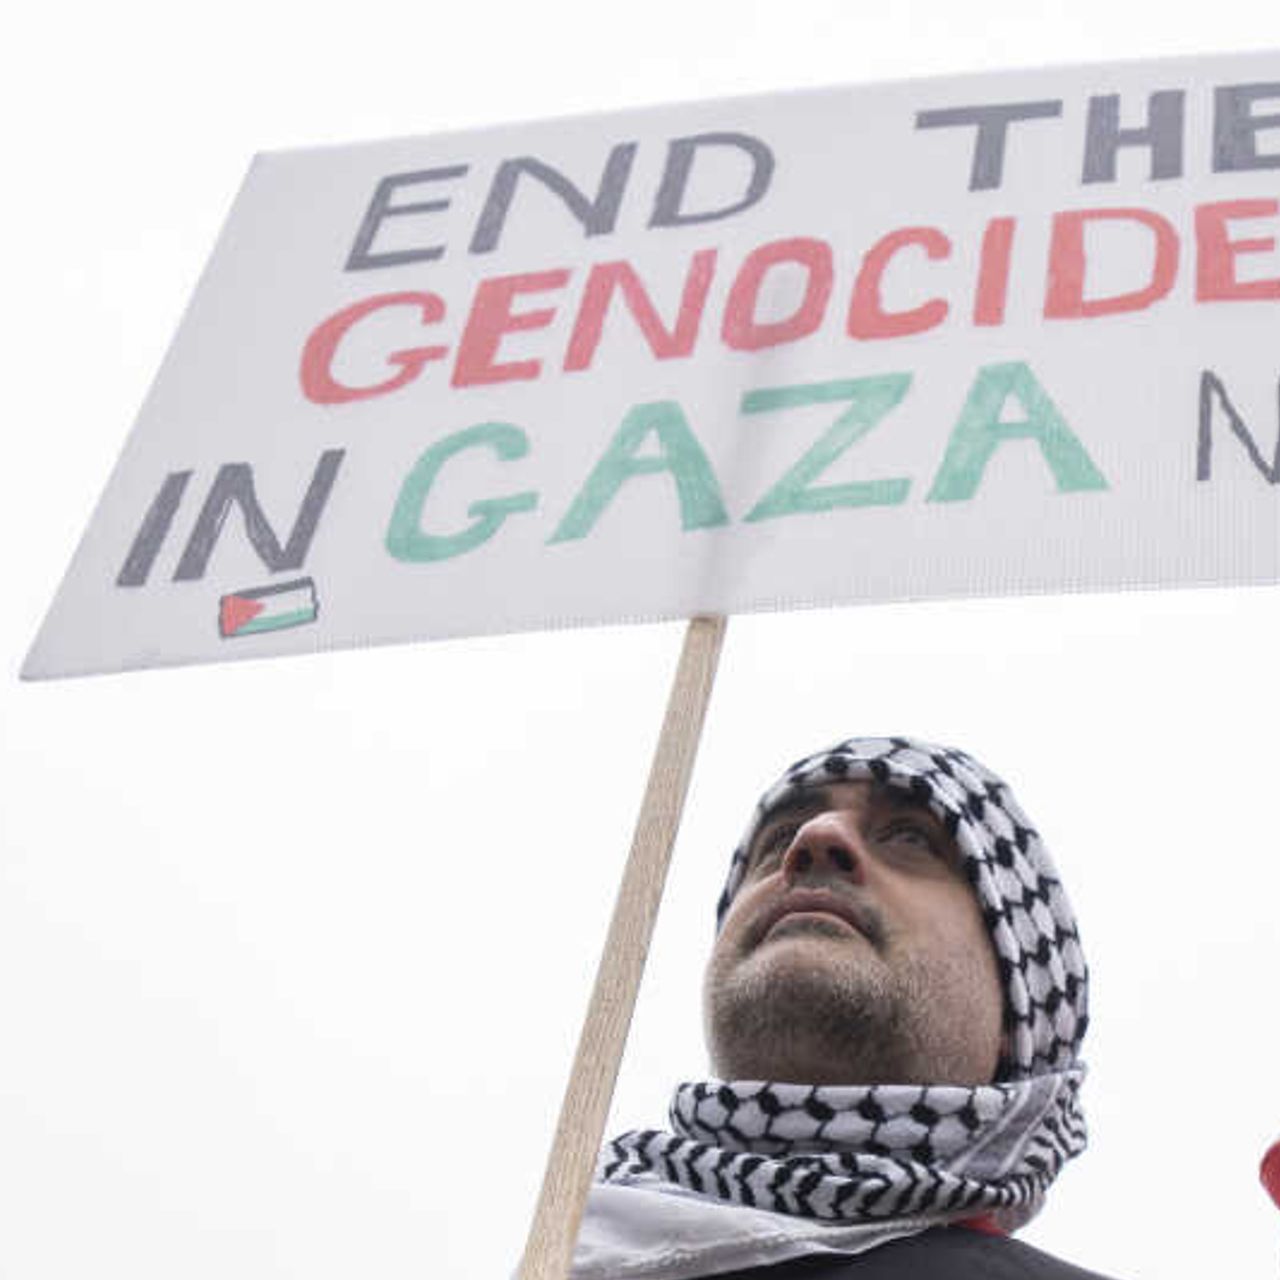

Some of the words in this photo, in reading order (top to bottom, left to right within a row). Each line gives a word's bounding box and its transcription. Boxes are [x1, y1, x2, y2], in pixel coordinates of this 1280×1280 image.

[344, 132, 776, 273] END
[116, 448, 346, 588] IN
[384, 361, 1111, 564] GAZA
